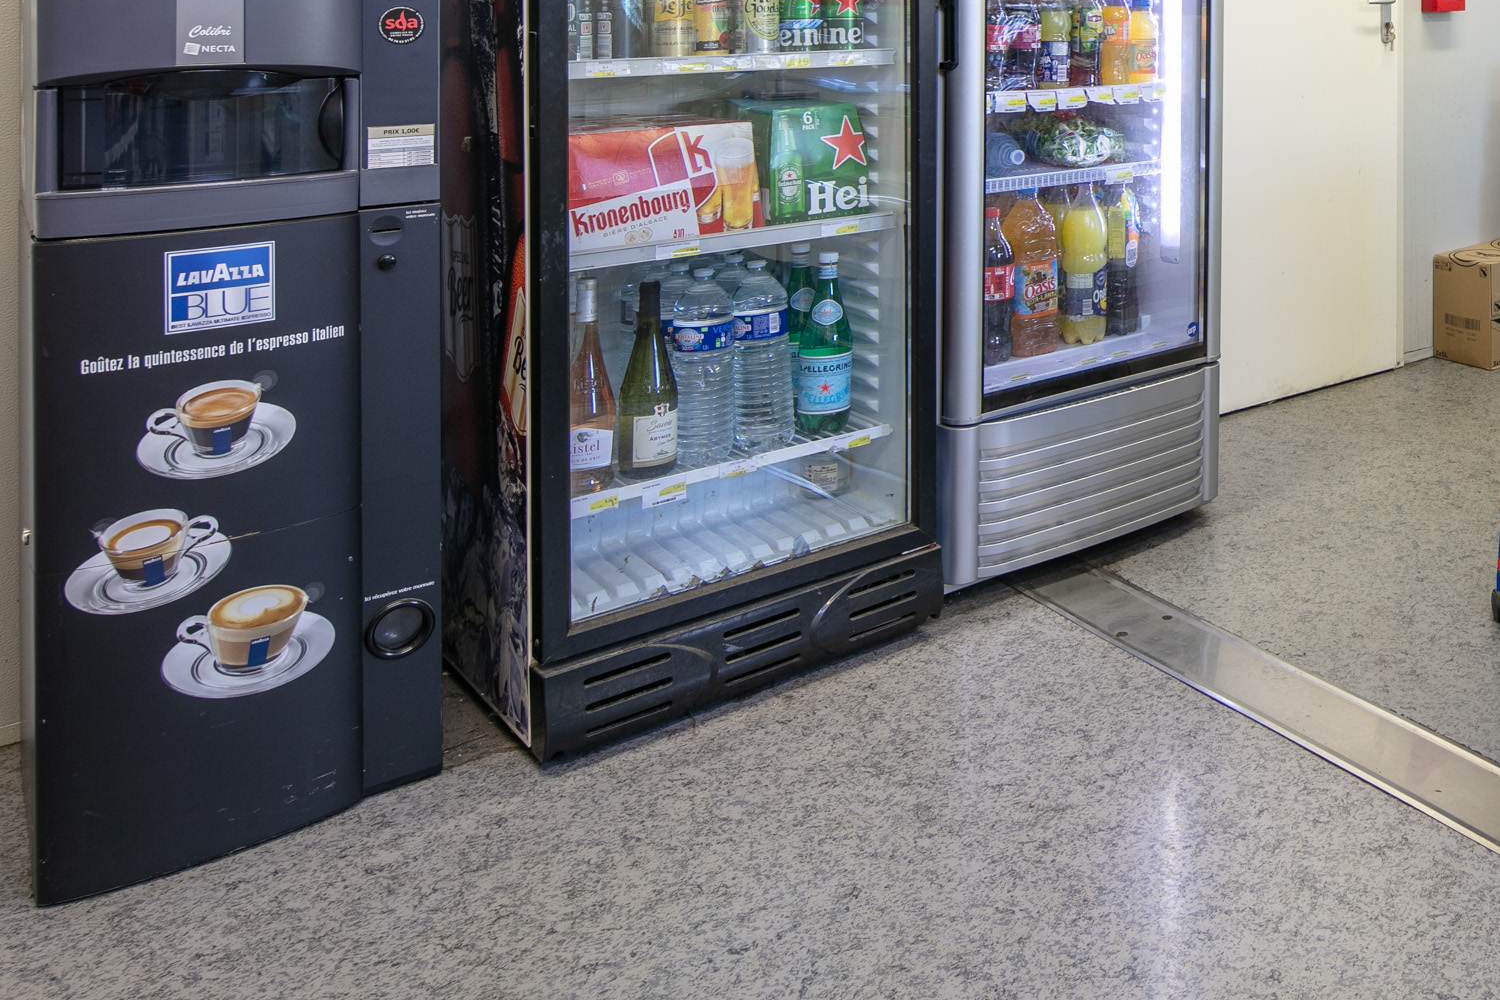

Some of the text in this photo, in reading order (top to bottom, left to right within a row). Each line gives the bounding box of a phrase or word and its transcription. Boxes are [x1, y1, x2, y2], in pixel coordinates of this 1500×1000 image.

[385, 10, 419, 31] sda
[201, 45, 236, 53] NECTA
[401, 127, 420, 135] 1,00€
[571, 189, 691, 238] Kronenbourg
[603, 226, 628, 238] BIÈRE
[176, 263, 265, 287] LAVAZZA
[1023, 277, 1057, 300] Oasis
[176, 285, 271, 321] BLUE
[187, 319, 213, 328] LAVAZZA
[213, 316, 241, 324] ULTIMATE
[241, 312, 271, 321] ESPRESSO
[80, 356, 124, 375] Goûtez
[128, 354, 140, 369] la
[144, 343, 226, 369] quintessence
[229, 340, 243, 355] de
[312, 324, 345, 342] italien
